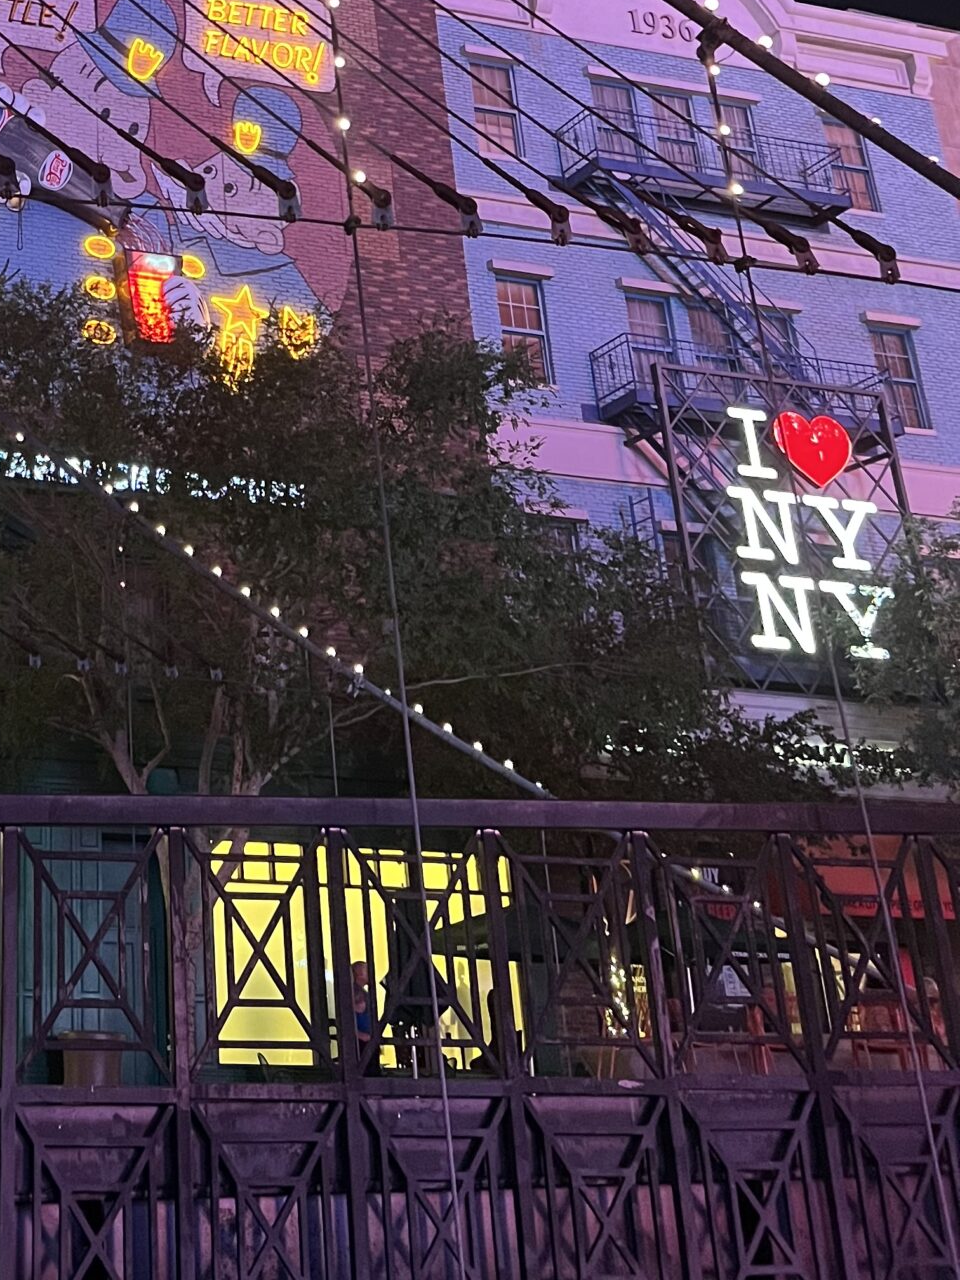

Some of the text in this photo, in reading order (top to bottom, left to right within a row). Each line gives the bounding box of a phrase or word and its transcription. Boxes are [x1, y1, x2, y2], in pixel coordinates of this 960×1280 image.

[204, 29, 326, 85] FLAVOR!
[726, 406, 779, 480] I
[726, 485, 878, 571] NY
[740, 571, 896, 660] NY
